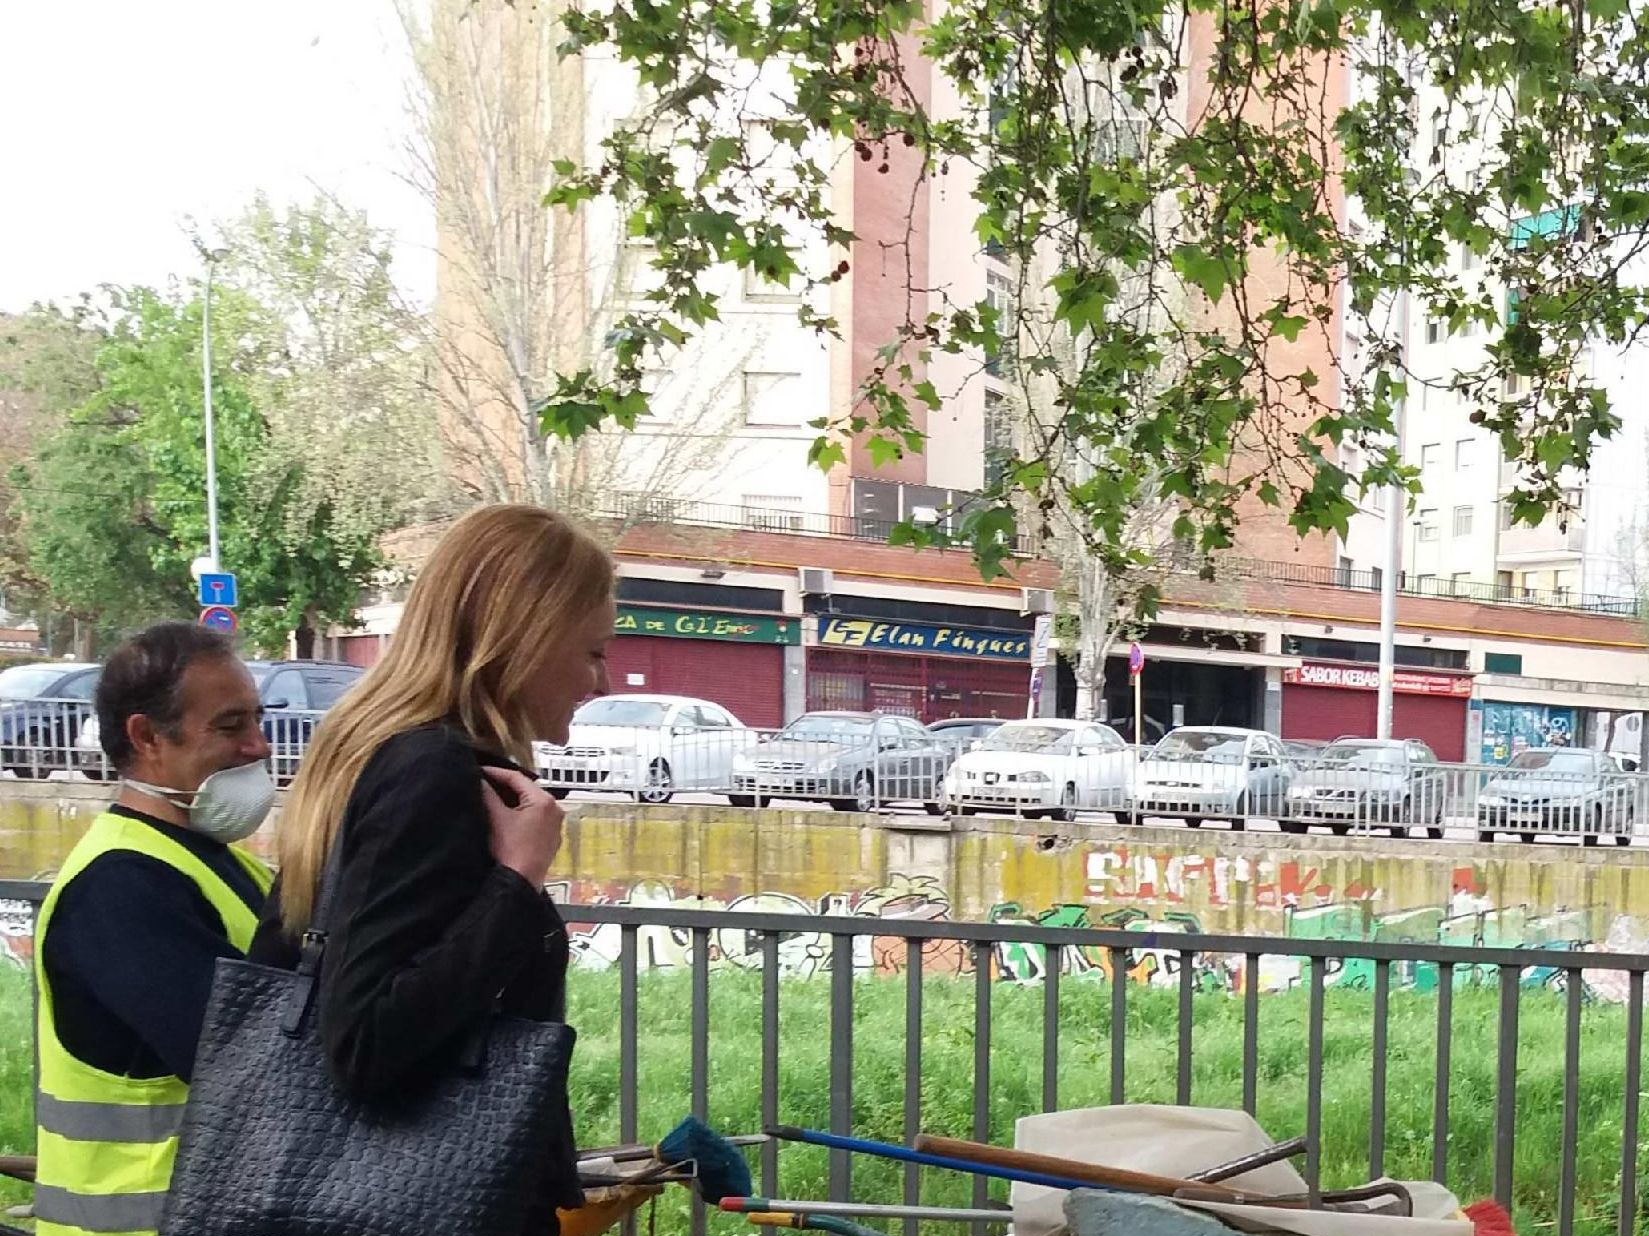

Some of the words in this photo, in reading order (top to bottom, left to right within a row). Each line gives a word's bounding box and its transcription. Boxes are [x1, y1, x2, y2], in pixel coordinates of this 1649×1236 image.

[645, 620, 666, 631] DE
[871, 624, 924, 645] Elan
[933, 628, 1026, 655] Finques
[1301, 666, 1341, 685] SABOR
[1341, 669, 1379, 688] KEBAB
